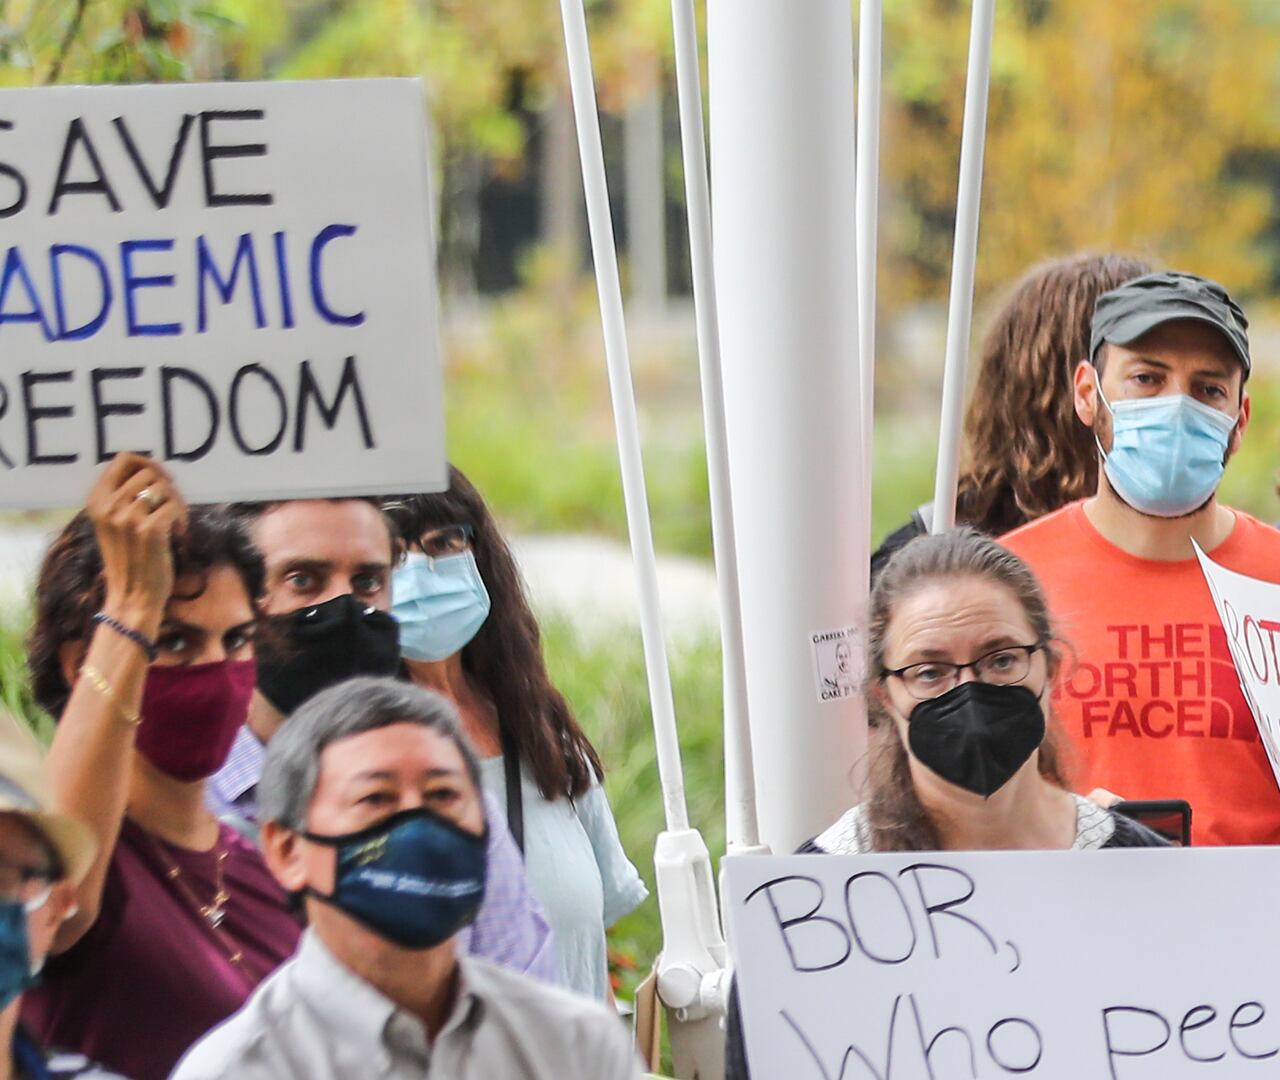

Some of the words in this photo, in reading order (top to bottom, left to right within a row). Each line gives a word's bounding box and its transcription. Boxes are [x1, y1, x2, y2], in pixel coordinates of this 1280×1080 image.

[1106, 623, 1205, 660] THE
[1081, 700, 1205, 739] FACE
[744, 862, 1021, 974] BOR,
